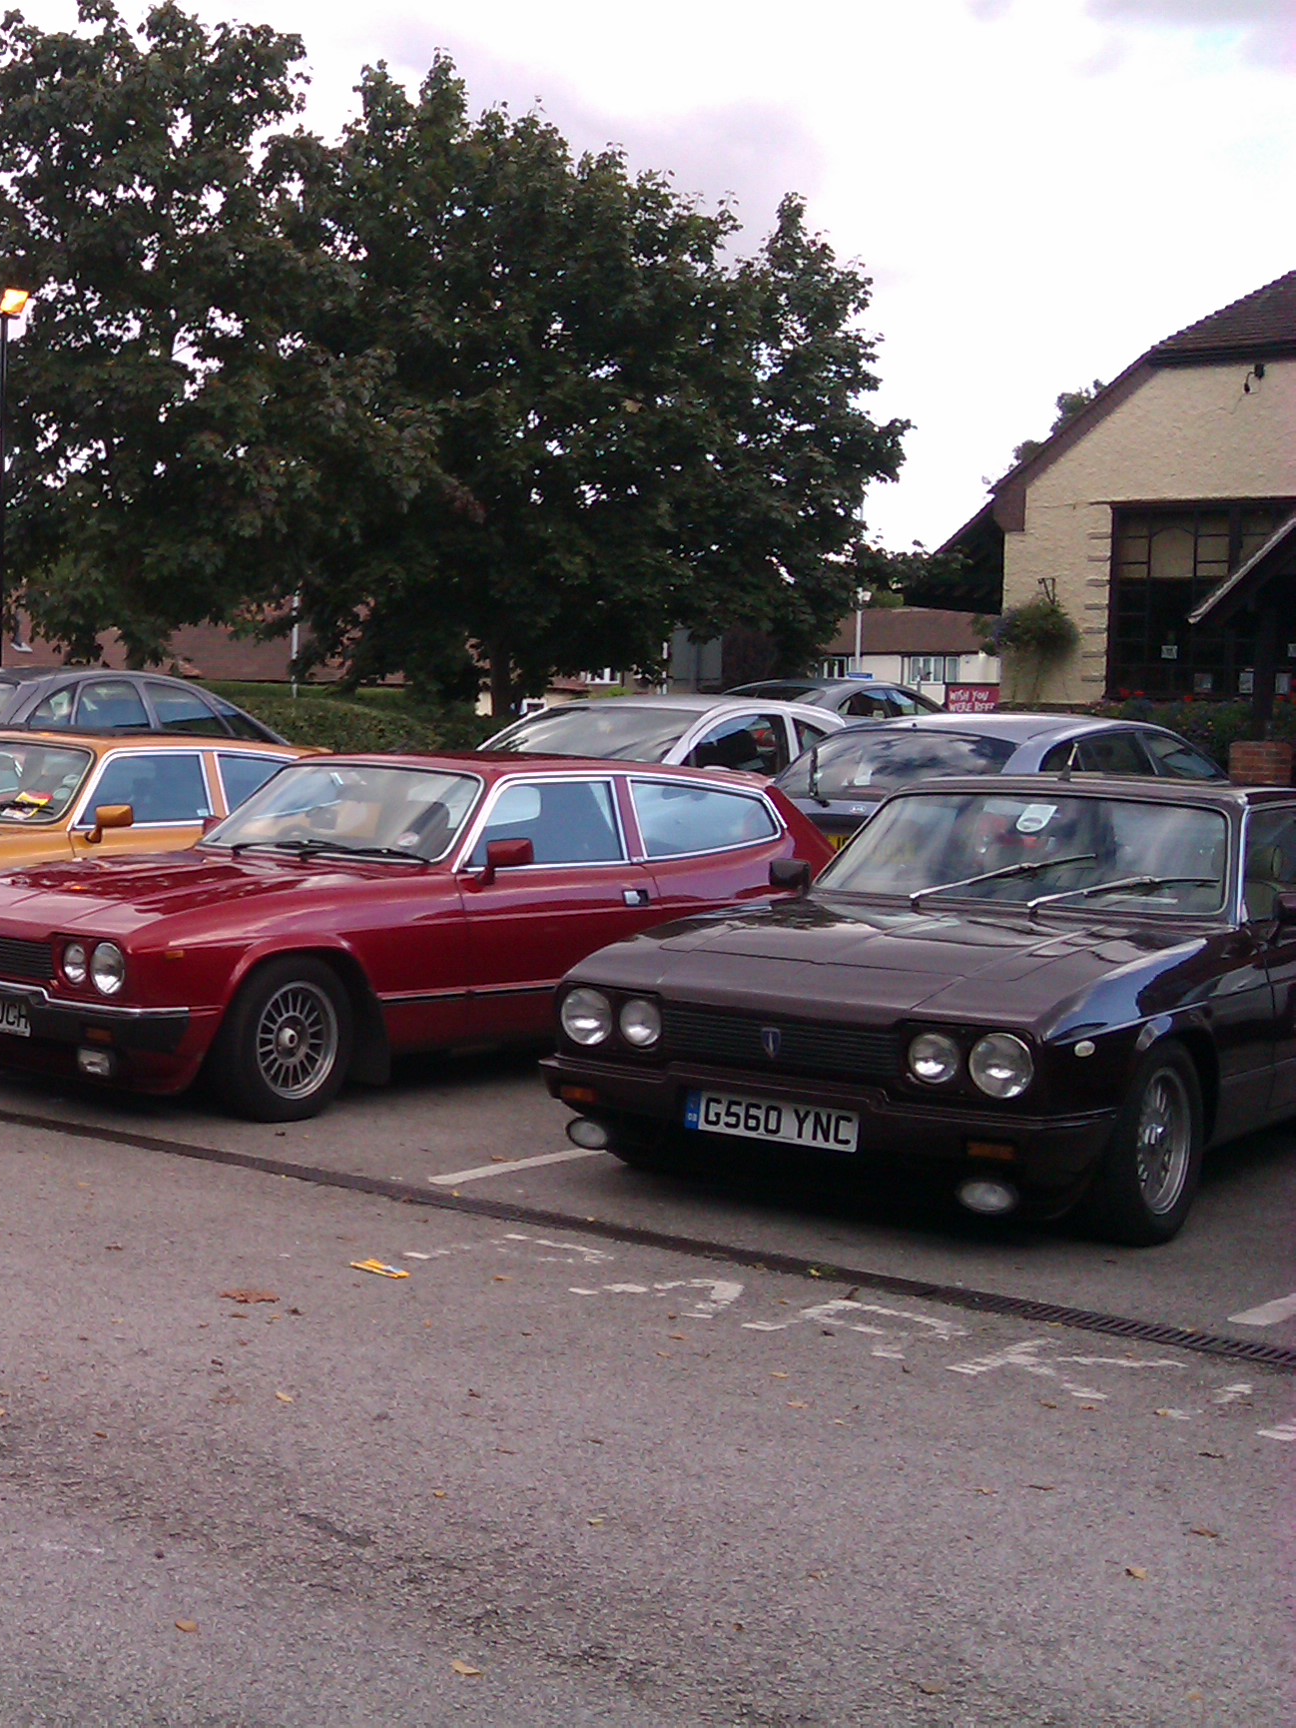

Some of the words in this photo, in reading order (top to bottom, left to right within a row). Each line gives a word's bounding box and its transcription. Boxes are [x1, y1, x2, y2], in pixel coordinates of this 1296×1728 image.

[950, 690, 970, 701] WISH
[972, 690, 989, 701] YOU
[704, 1097, 783, 1135] G560
[793, 1108, 854, 1146] YNC
